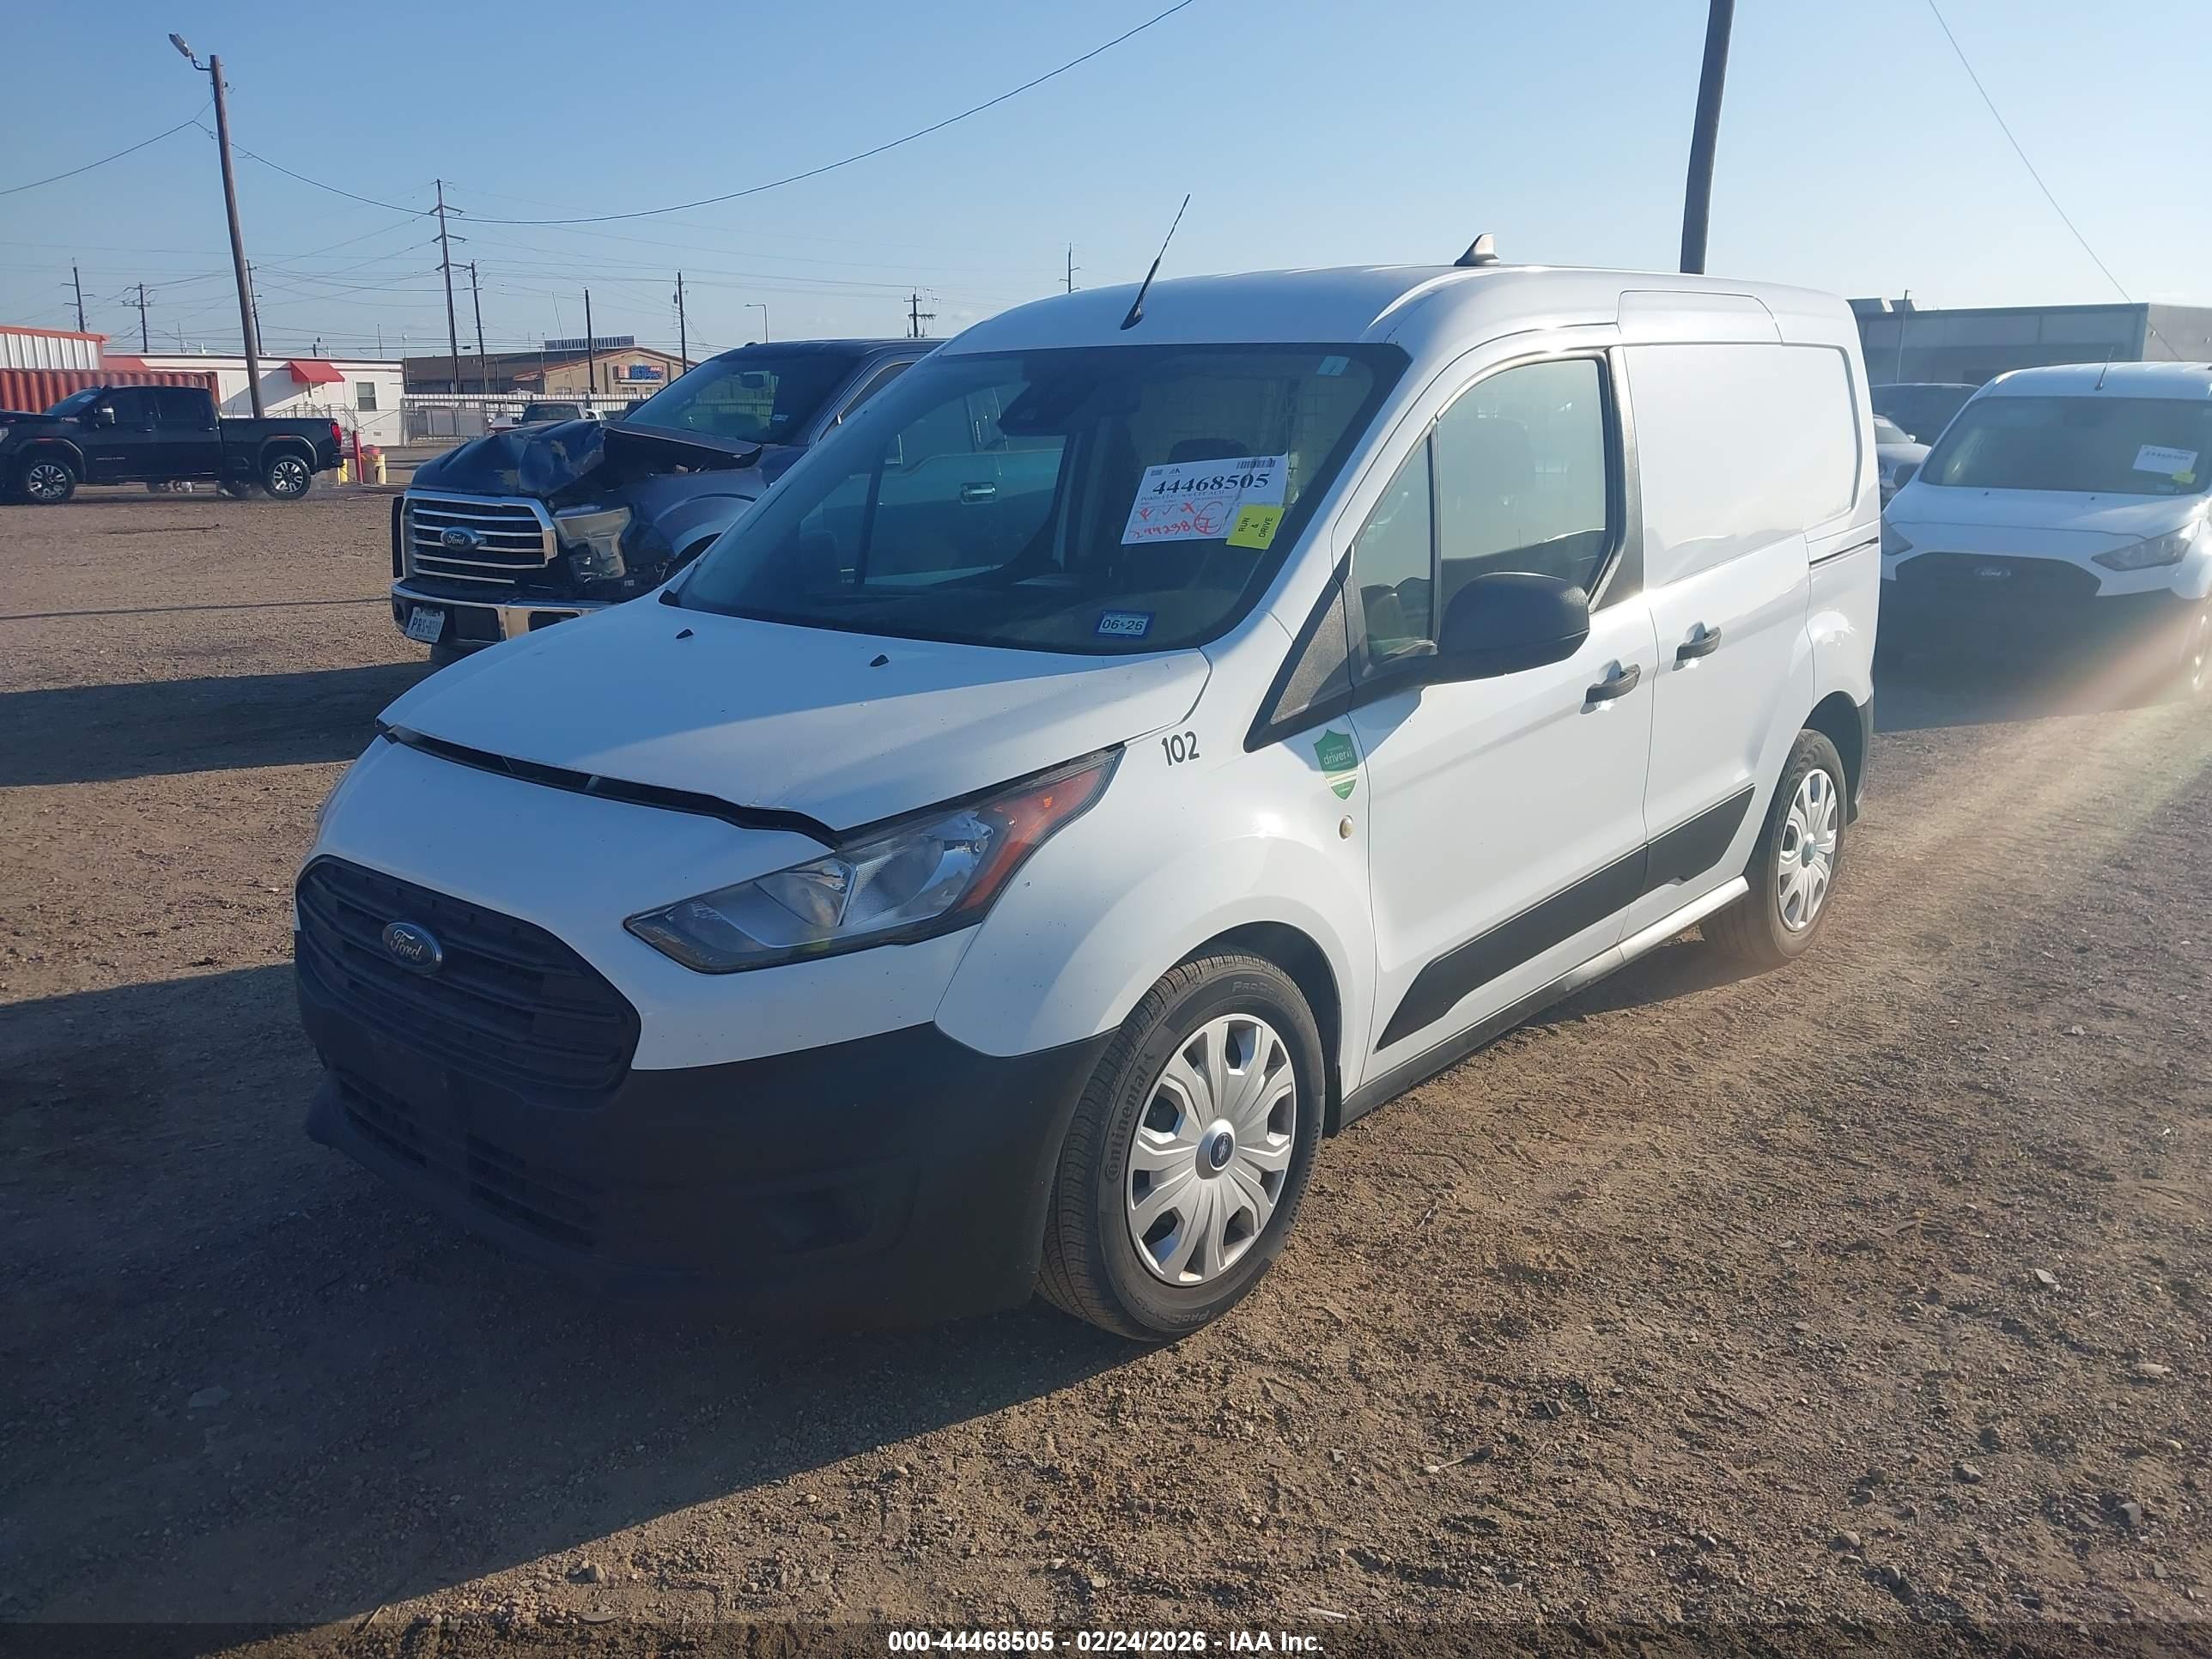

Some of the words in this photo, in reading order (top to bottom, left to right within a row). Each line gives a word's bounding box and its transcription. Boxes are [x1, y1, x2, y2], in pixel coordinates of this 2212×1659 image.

[1152, 473, 1270, 495] 44468505
[1238, 517, 1250, 532] RUN
[1259, 517, 1273, 537] DRIVE
[447, 533, 465, 544] Ford
[1161, 731, 1200, 766] 102
[391, 929, 422, 961] Ford
[1104, 1064, 1149, 1182] Continental
